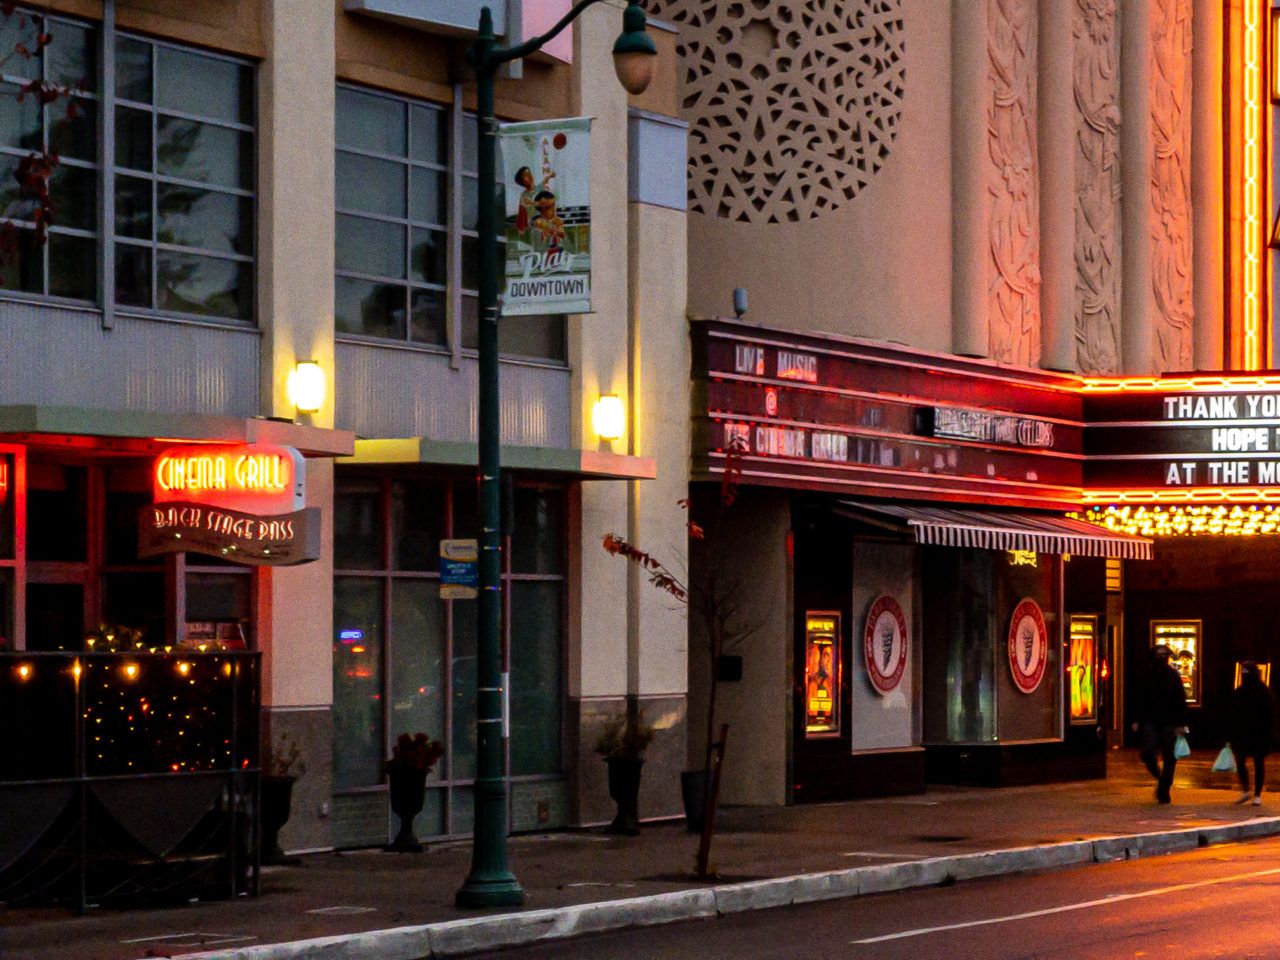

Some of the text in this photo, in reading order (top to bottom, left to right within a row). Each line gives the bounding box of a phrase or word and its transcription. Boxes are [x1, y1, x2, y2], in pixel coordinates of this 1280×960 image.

[519, 250, 575, 279] Play
[510, 280, 585, 298] DOWNTOWN
[735, 344, 818, 382] LIVE MUSIC
[1164, 396, 1237, 419] THANK
[756, 426, 805, 457] CINEMA
[1211, 427, 1269, 451] HOPE
[156, 454, 286, 490] CINEMA GRILL
[1165, 462, 1197, 485] AT
[1208, 461, 1250, 485] THE
[153, 507, 295, 540] BACK STAGE PASS
